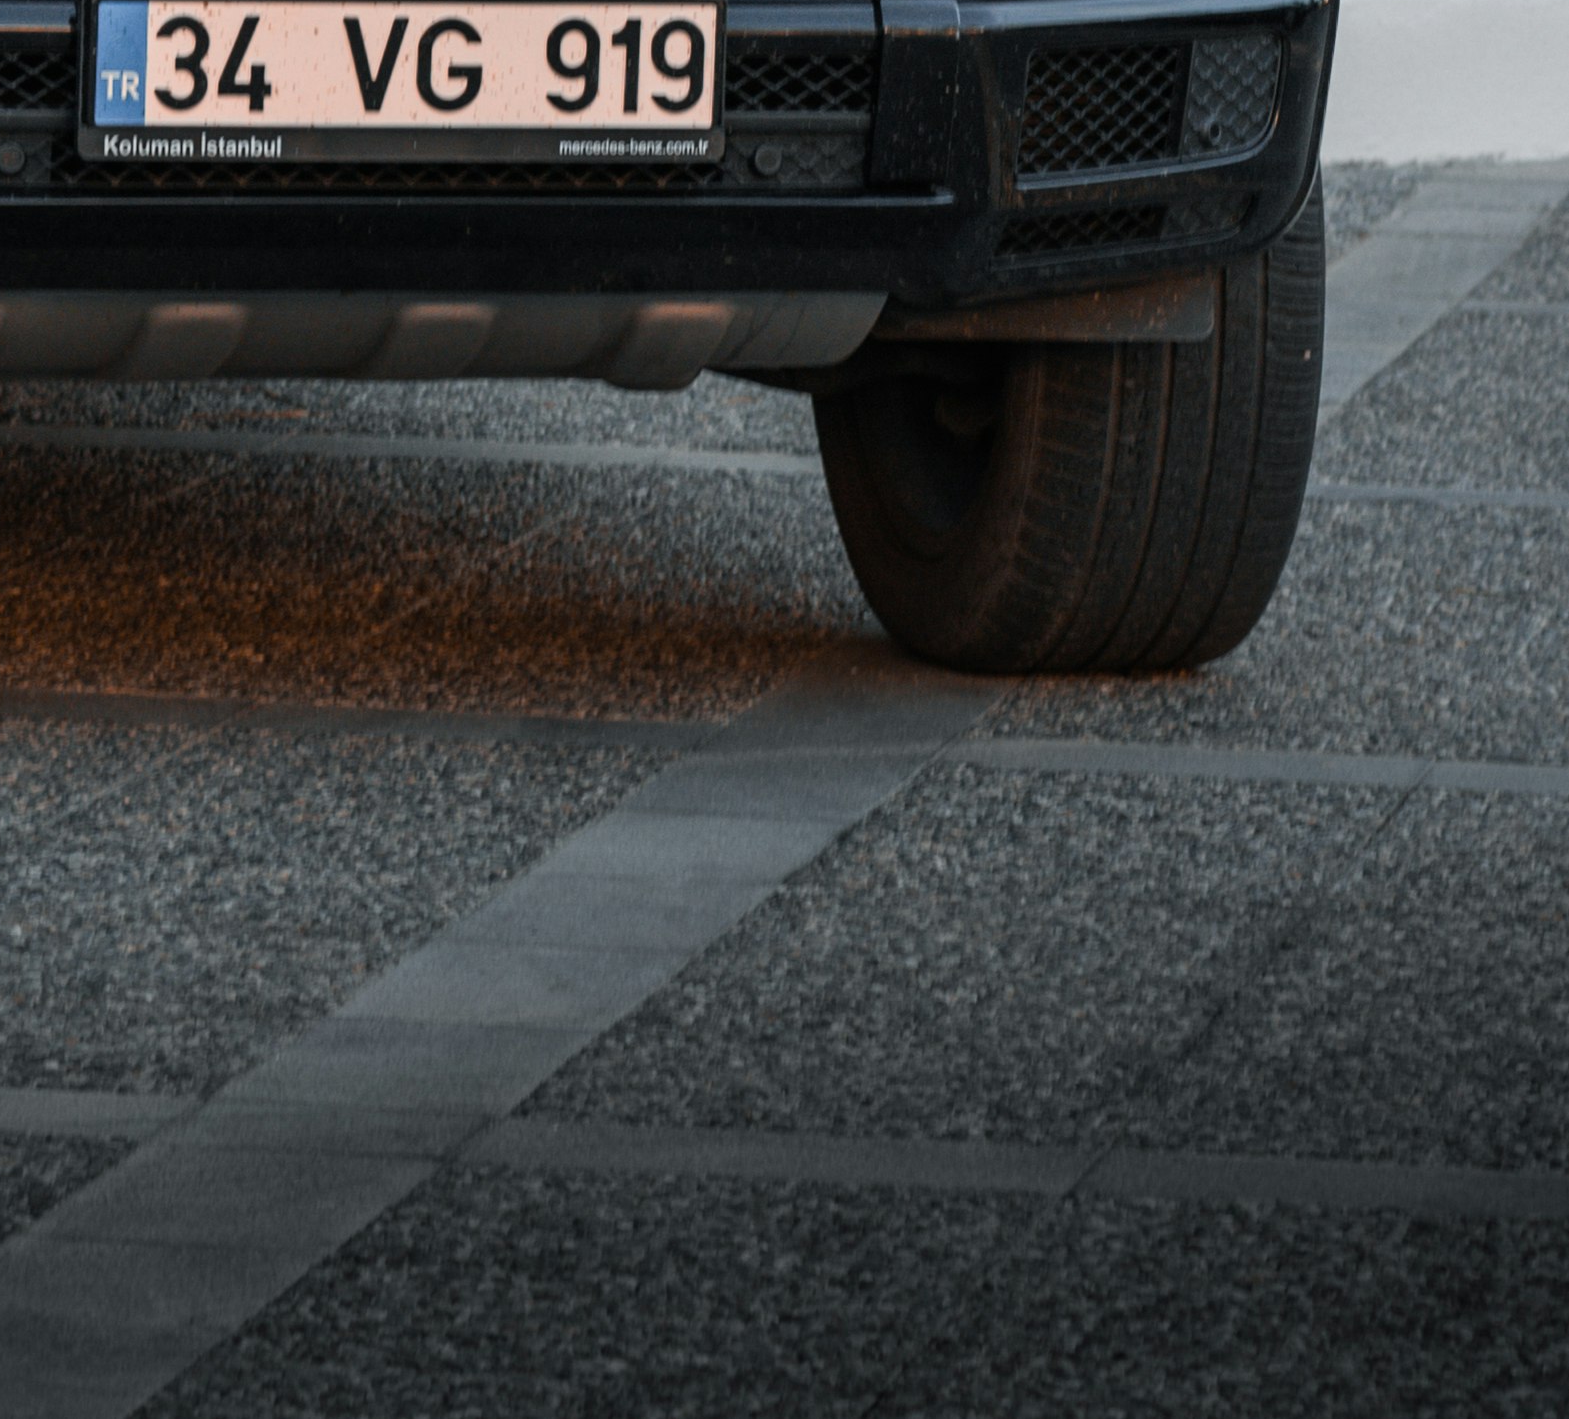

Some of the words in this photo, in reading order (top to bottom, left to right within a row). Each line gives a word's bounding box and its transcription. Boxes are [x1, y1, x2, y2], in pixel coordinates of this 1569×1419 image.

[154, 15, 272, 113] 34
[343, 15, 484, 113] VG
[545, 16, 706, 114] 919
[101, 70, 140, 102] TR
[103, 133, 194, 158] Koluman
[559, 137, 710, 156] mercedes-benz.com.tr
